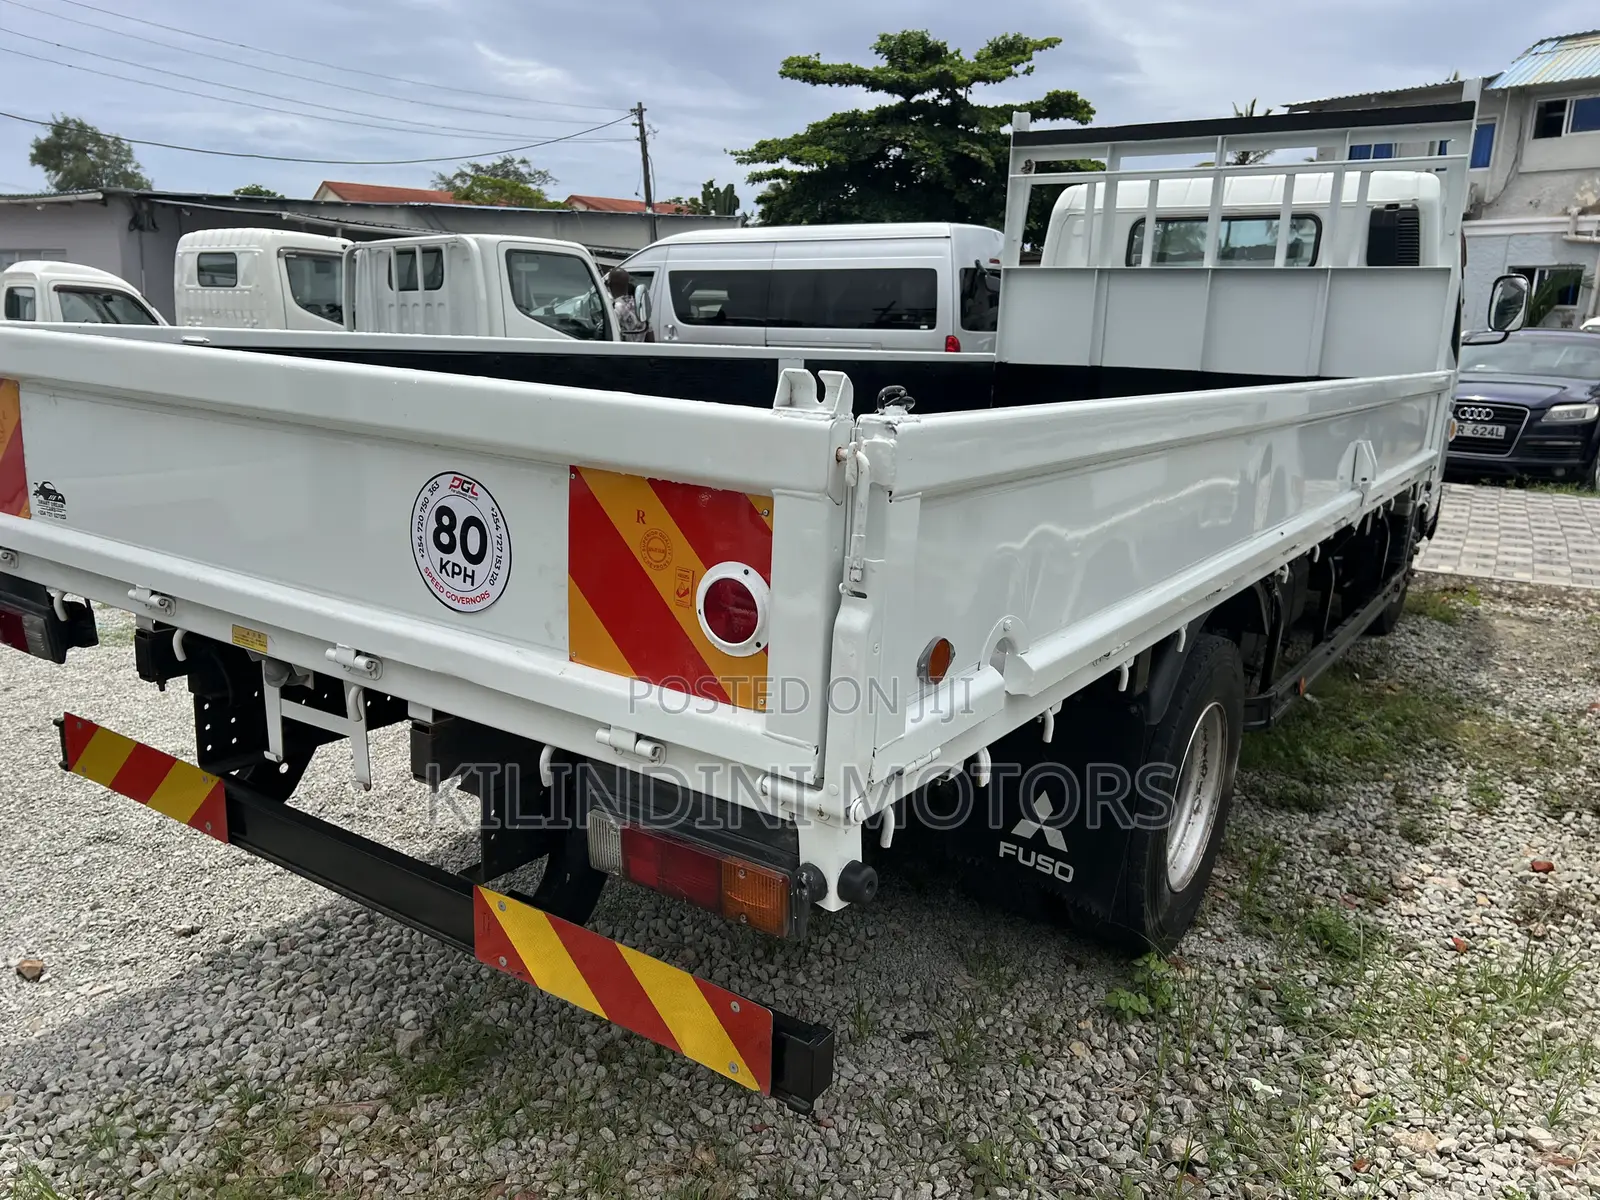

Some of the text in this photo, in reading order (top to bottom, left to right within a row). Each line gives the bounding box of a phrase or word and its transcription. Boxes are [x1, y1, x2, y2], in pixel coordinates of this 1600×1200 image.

[1471, 426, 1503, 437] 624L
[427, 481, 440, 497] 363
[419, 496, 430, 514] 750
[636, 509, 646, 525] R
[490, 506, 501, 531] +254
[417, 535, 425, 559] +254
[432, 505, 488, 566] 80
[439, 557, 476, 587] KPH
[488, 571, 499, 586] 120
[424, 566, 490, 605] SPEED GOVERNORS
[998, 841, 1075, 883] FUSO
